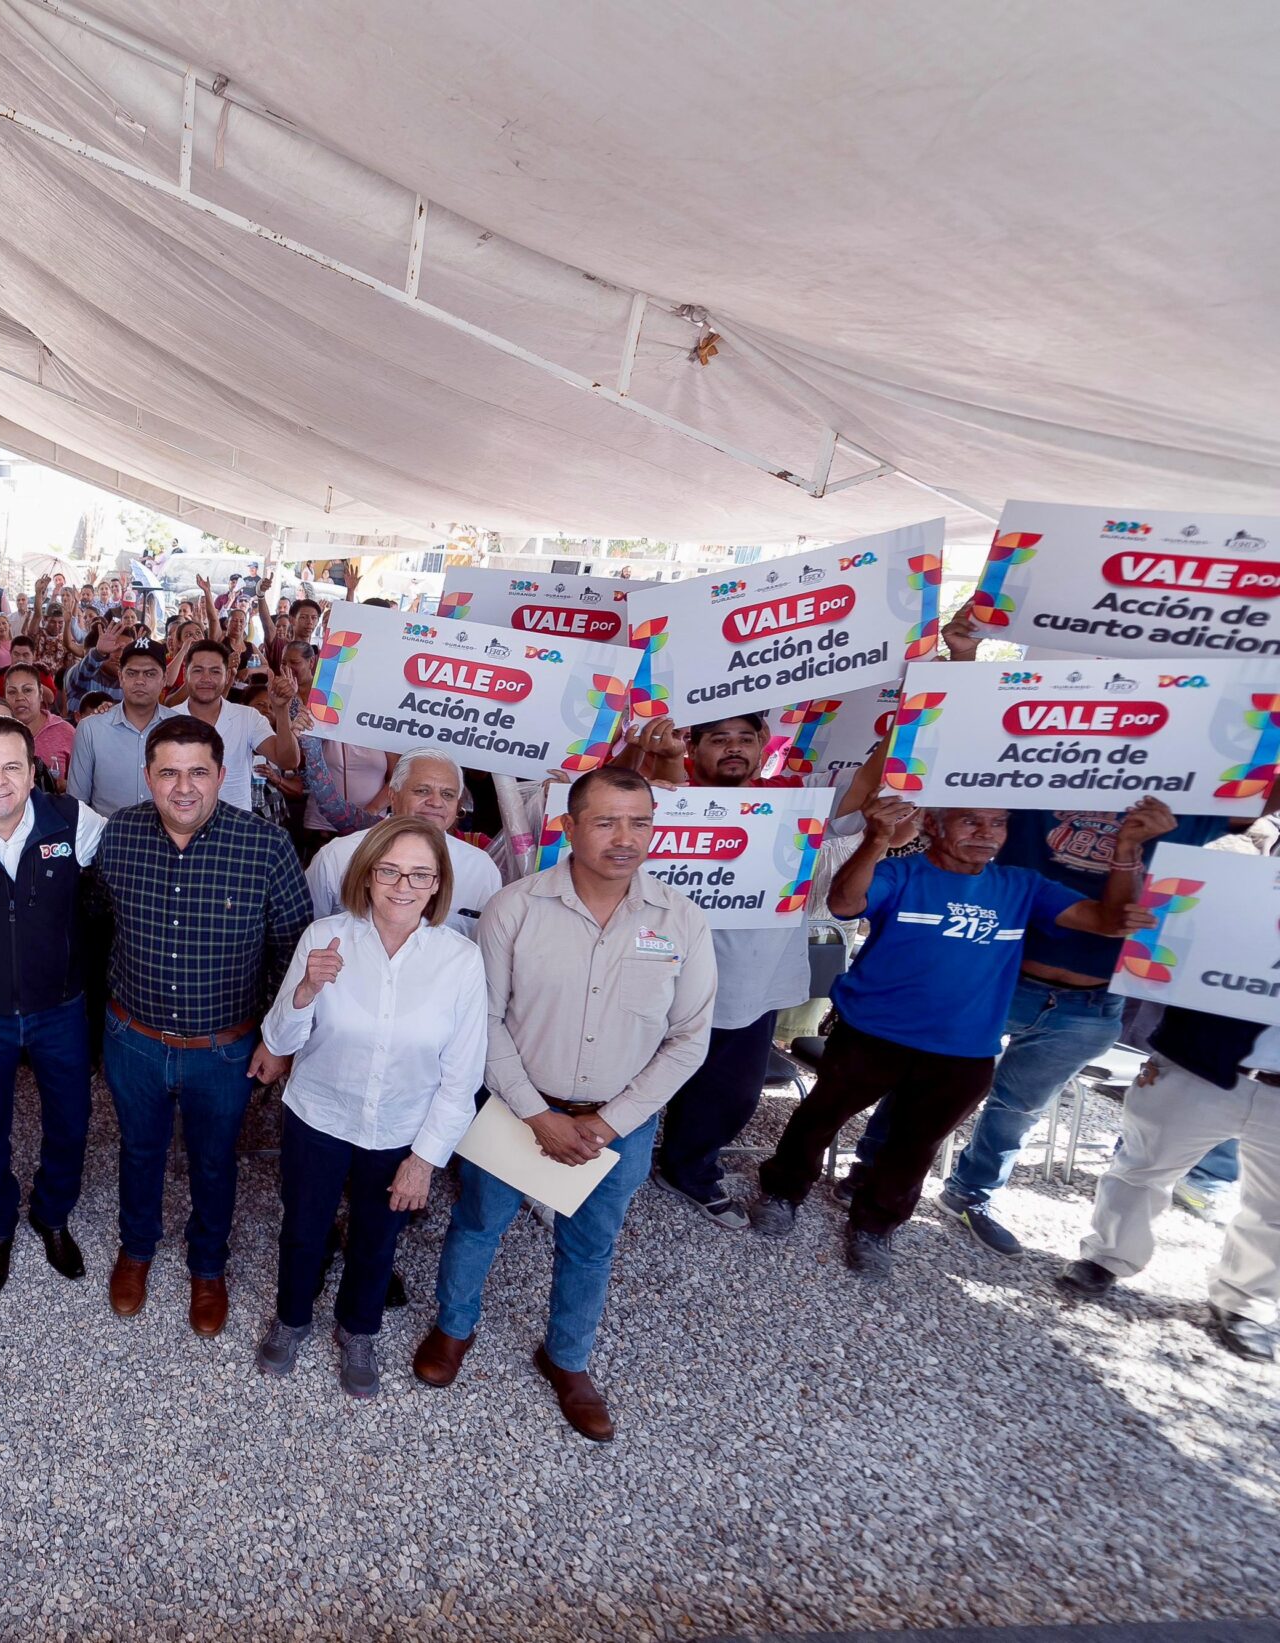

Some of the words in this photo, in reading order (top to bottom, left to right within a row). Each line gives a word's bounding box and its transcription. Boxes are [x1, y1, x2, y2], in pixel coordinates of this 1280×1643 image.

[1103, 520, 1152, 535] 2024
[1122, 556, 1239, 589] VALE
[510, 580, 539, 591] 2024
[711, 580, 747, 598] 2024
[711, 593, 746, 605] DURANGO
[1092, 592, 1214, 622] Acción
[1220, 605, 1270, 627] de
[522, 610, 588, 634] VALE
[590, 621, 615, 632] por
[734, 597, 816, 636] VALE
[820, 596, 849, 616] por
[402, 636, 434, 645] DURANGO
[403, 623, 437, 638] 2024
[1033, 612, 1144, 639] cuarto
[1148, 625, 1280, 655] adicion
[727, 636, 812, 672] Acción
[817, 629, 850, 651] de
[417, 658, 494, 692] VALE
[494, 679, 525, 692] por
[686, 674, 771, 704] cuarto
[775, 641, 888, 686] adicional
[999, 672, 1043, 684] 2024
[398, 692, 480, 723] Acción
[483, 708, 515, 729] de
[1018, 706, 1118, 731] VALE
[1118, 713, 1160, 728] por
[356, 711, 435, 739] cuarto
[436, 726, 550, 760] adicional
[997, 741, 1101, 764] Acción
[1107, 744, 1148, 765] de
[944, 769, 1044, 788] cuarto
[1048, 767, 1196, 792] adicional
[715, 837, 742, 851] por
[648, 864, 704, 886] ción
[707, 866, 735, 886] de
[686, 888, 766, 910] icional
[636, 937, 674, 951] LERDO
[1201, 970, 1280, 998] cuar
